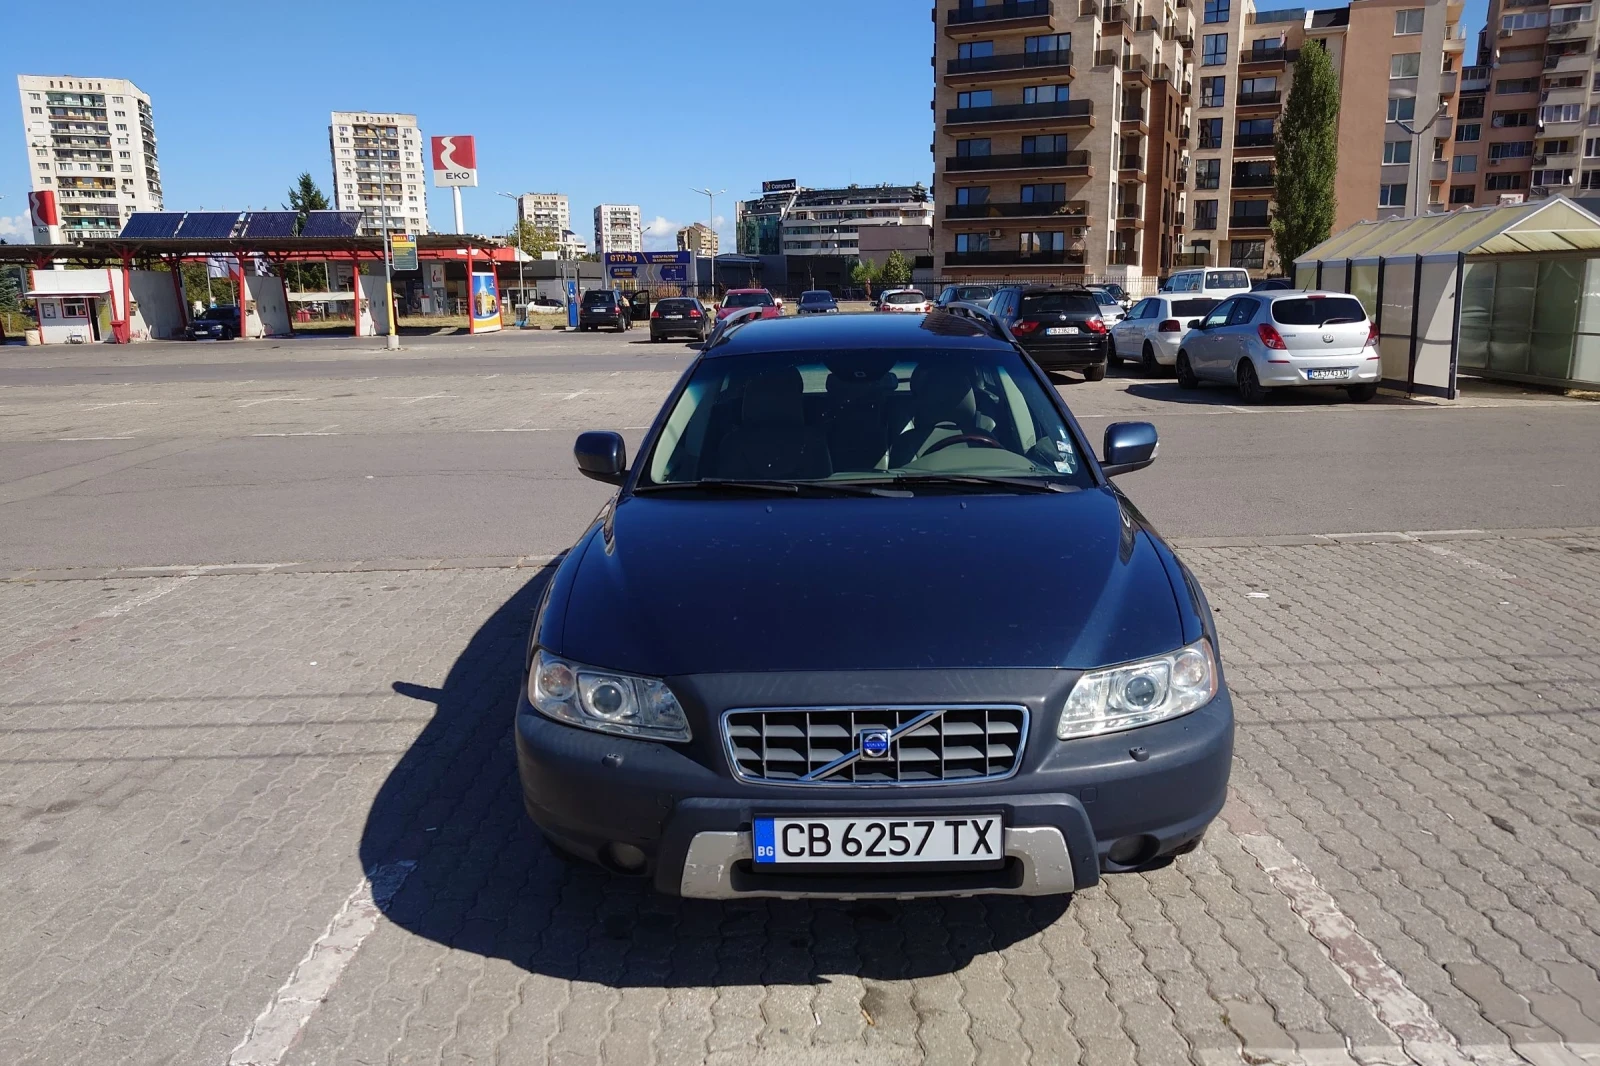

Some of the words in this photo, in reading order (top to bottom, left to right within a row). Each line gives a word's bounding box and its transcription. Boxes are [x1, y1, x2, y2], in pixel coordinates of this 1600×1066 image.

[445, 171, 470, 180] EKO
[610, 254, 637, 263] GTP.bg
[782, 823, 832, 857] CB
[841, 821, 935, 857] 6257
[944, 819, 994, 855] TX
[757, 847, 774, 857] BG
